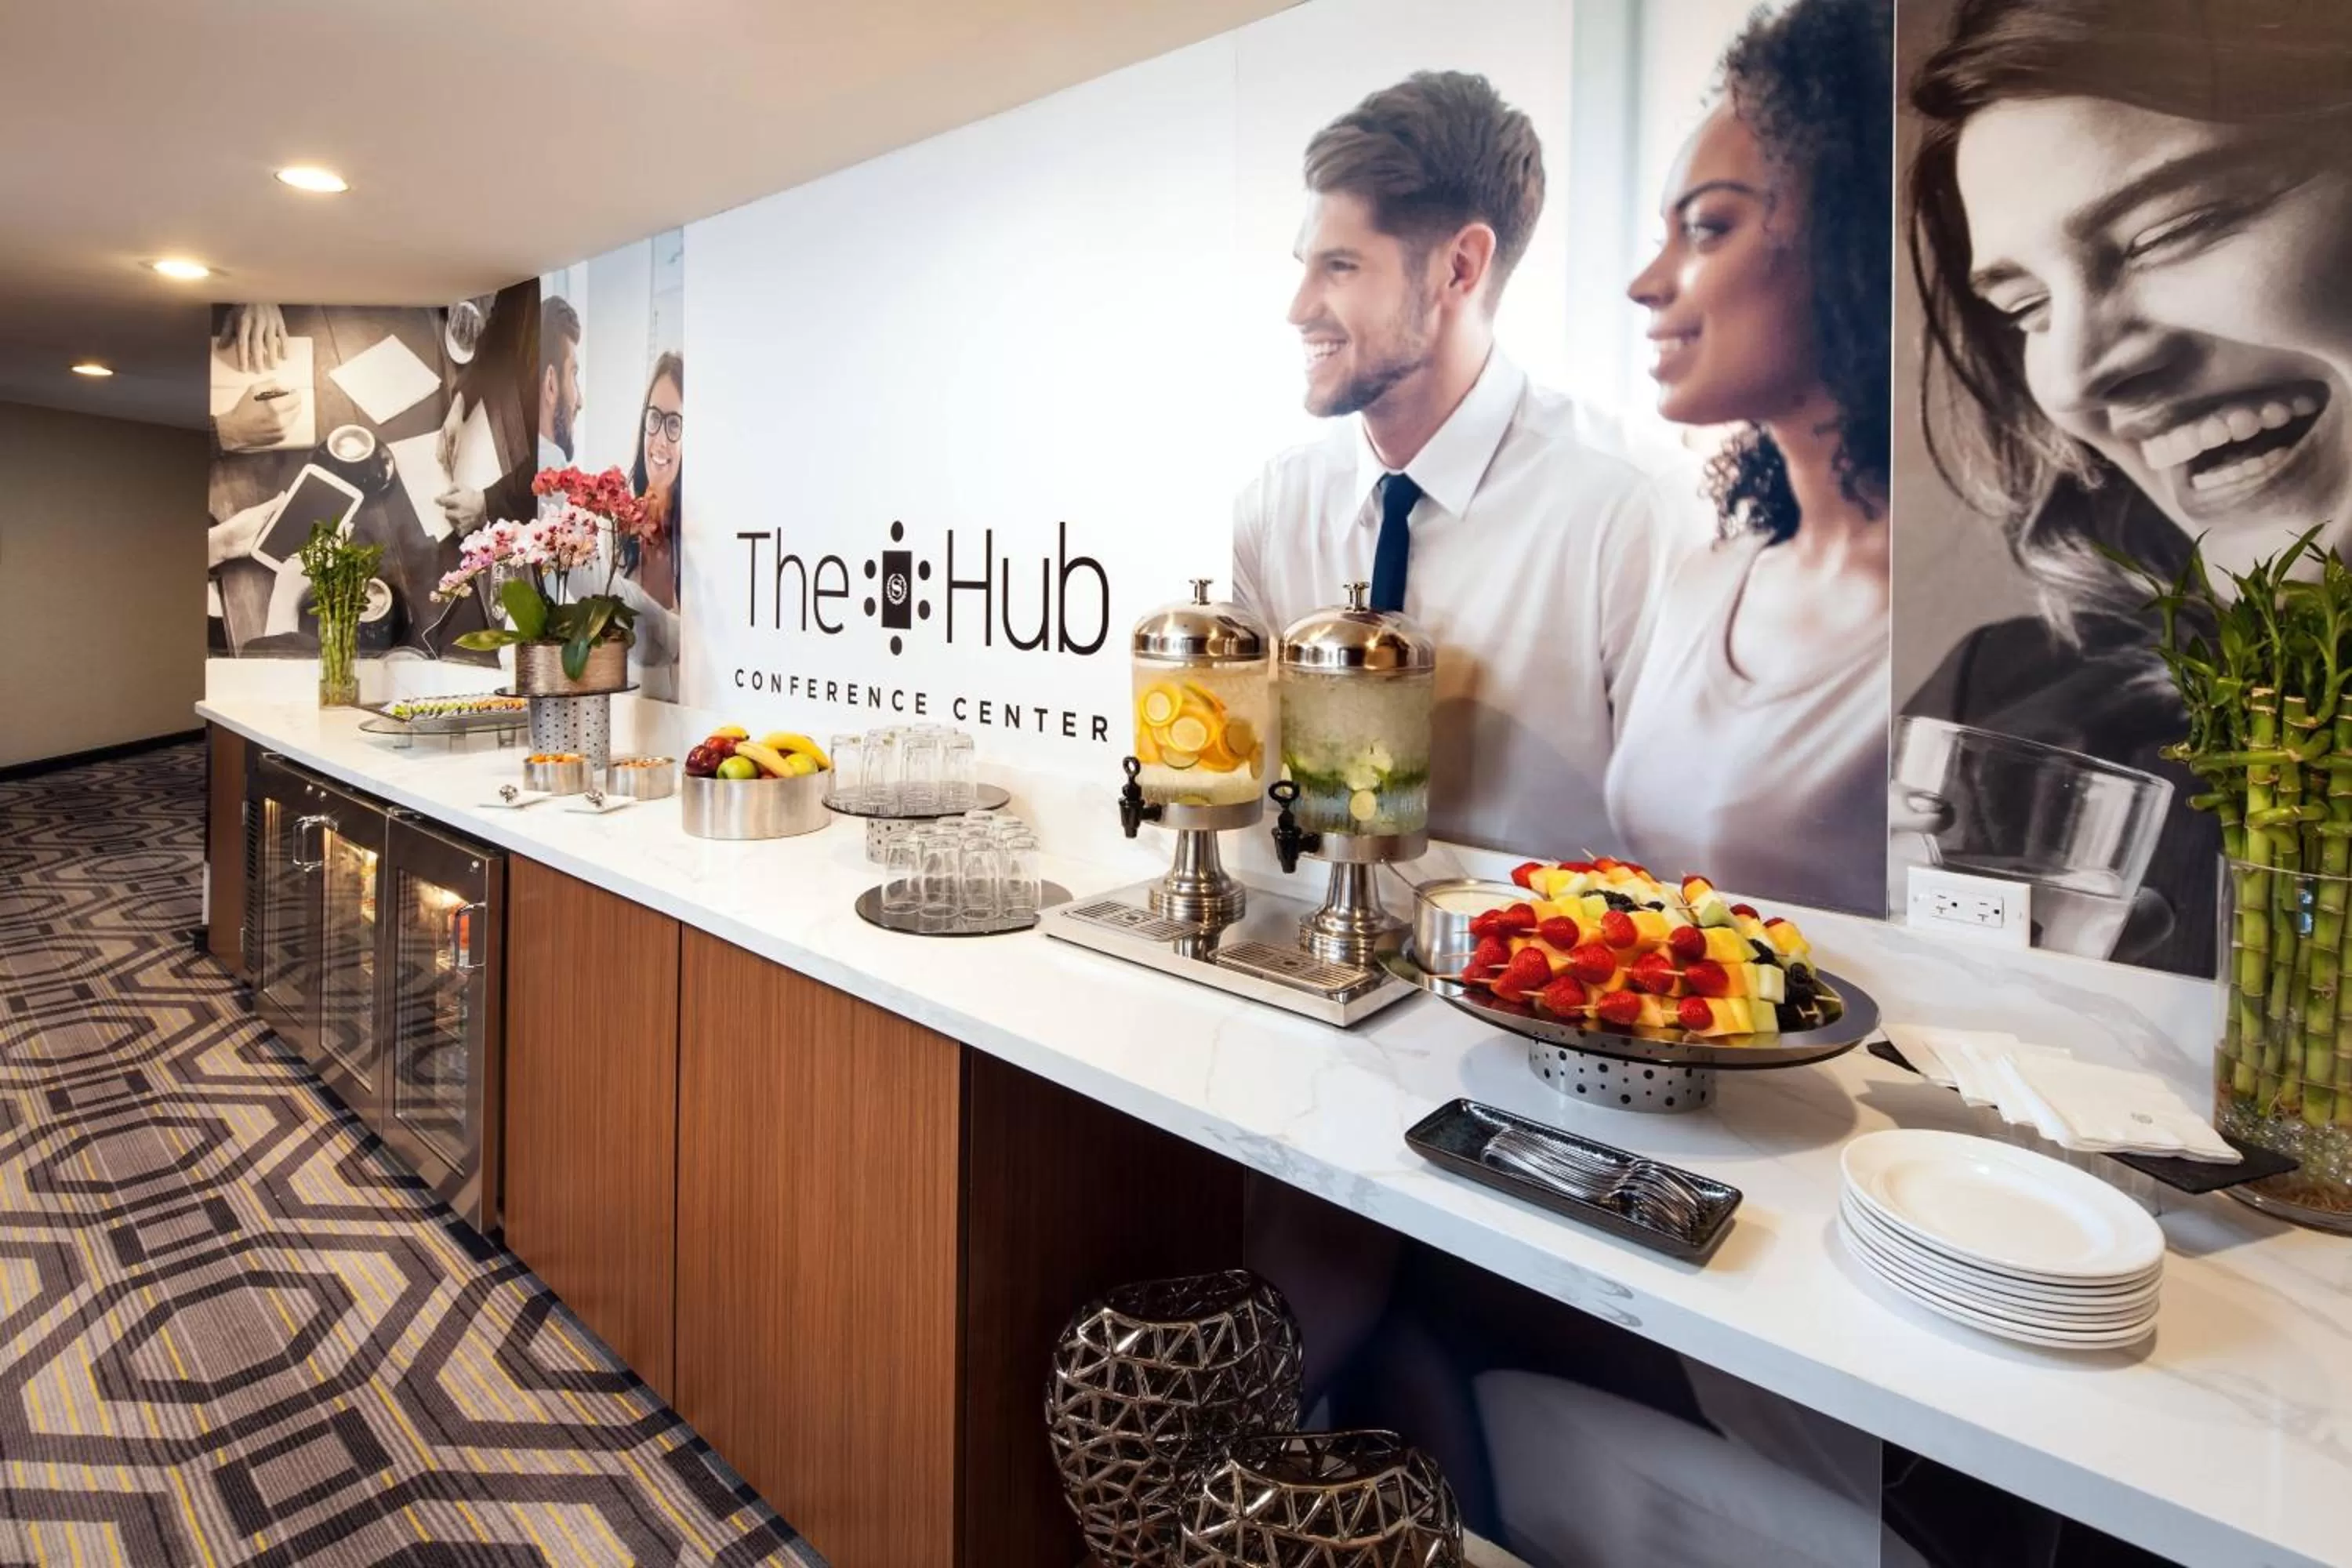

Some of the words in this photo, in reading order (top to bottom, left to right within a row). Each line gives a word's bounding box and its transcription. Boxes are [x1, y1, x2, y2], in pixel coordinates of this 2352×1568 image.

[736, 527, 849, 634] The
[946, 521, 1109, 656] Hub
[735, 669, 927, 715] CONFERENCE
[953, 697, 1108, 742] CENTER
